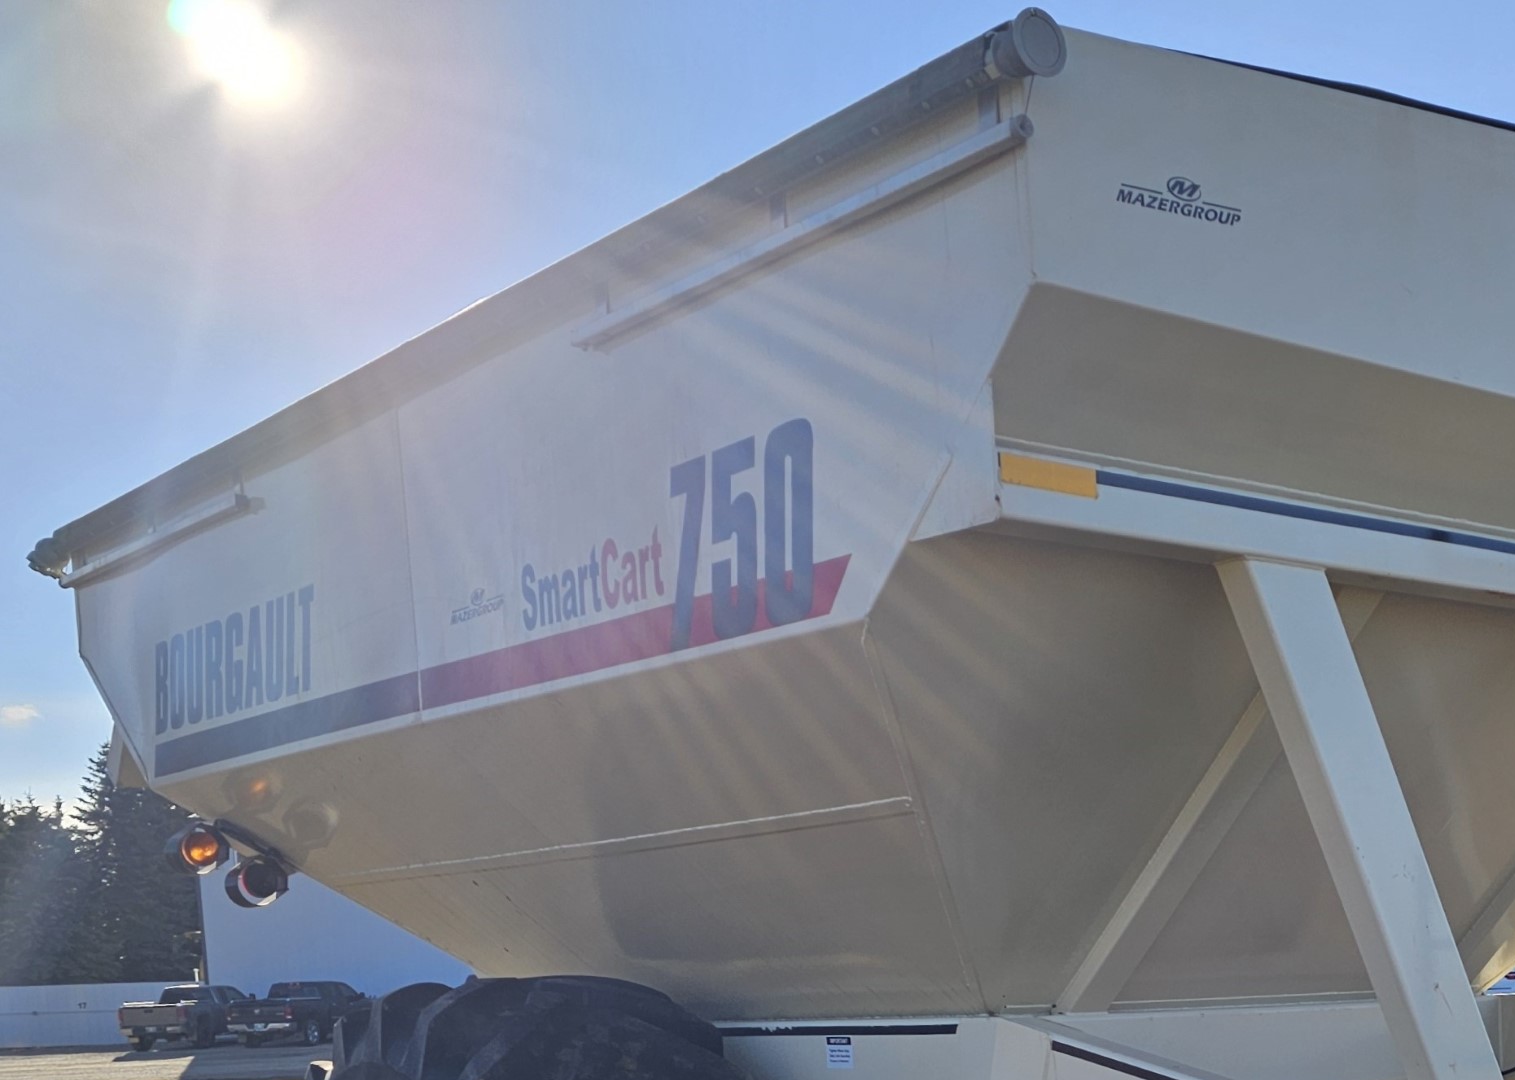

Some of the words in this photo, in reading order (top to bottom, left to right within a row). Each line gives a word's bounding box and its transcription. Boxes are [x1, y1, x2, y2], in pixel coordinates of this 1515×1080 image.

[1116, 188, 1241, 226] MAZERGROUP
[521, 523, 664, 632] SmartCart
[669, 417, 814, 653] 750
[155, 583, 314, 736] BOURGAULT
